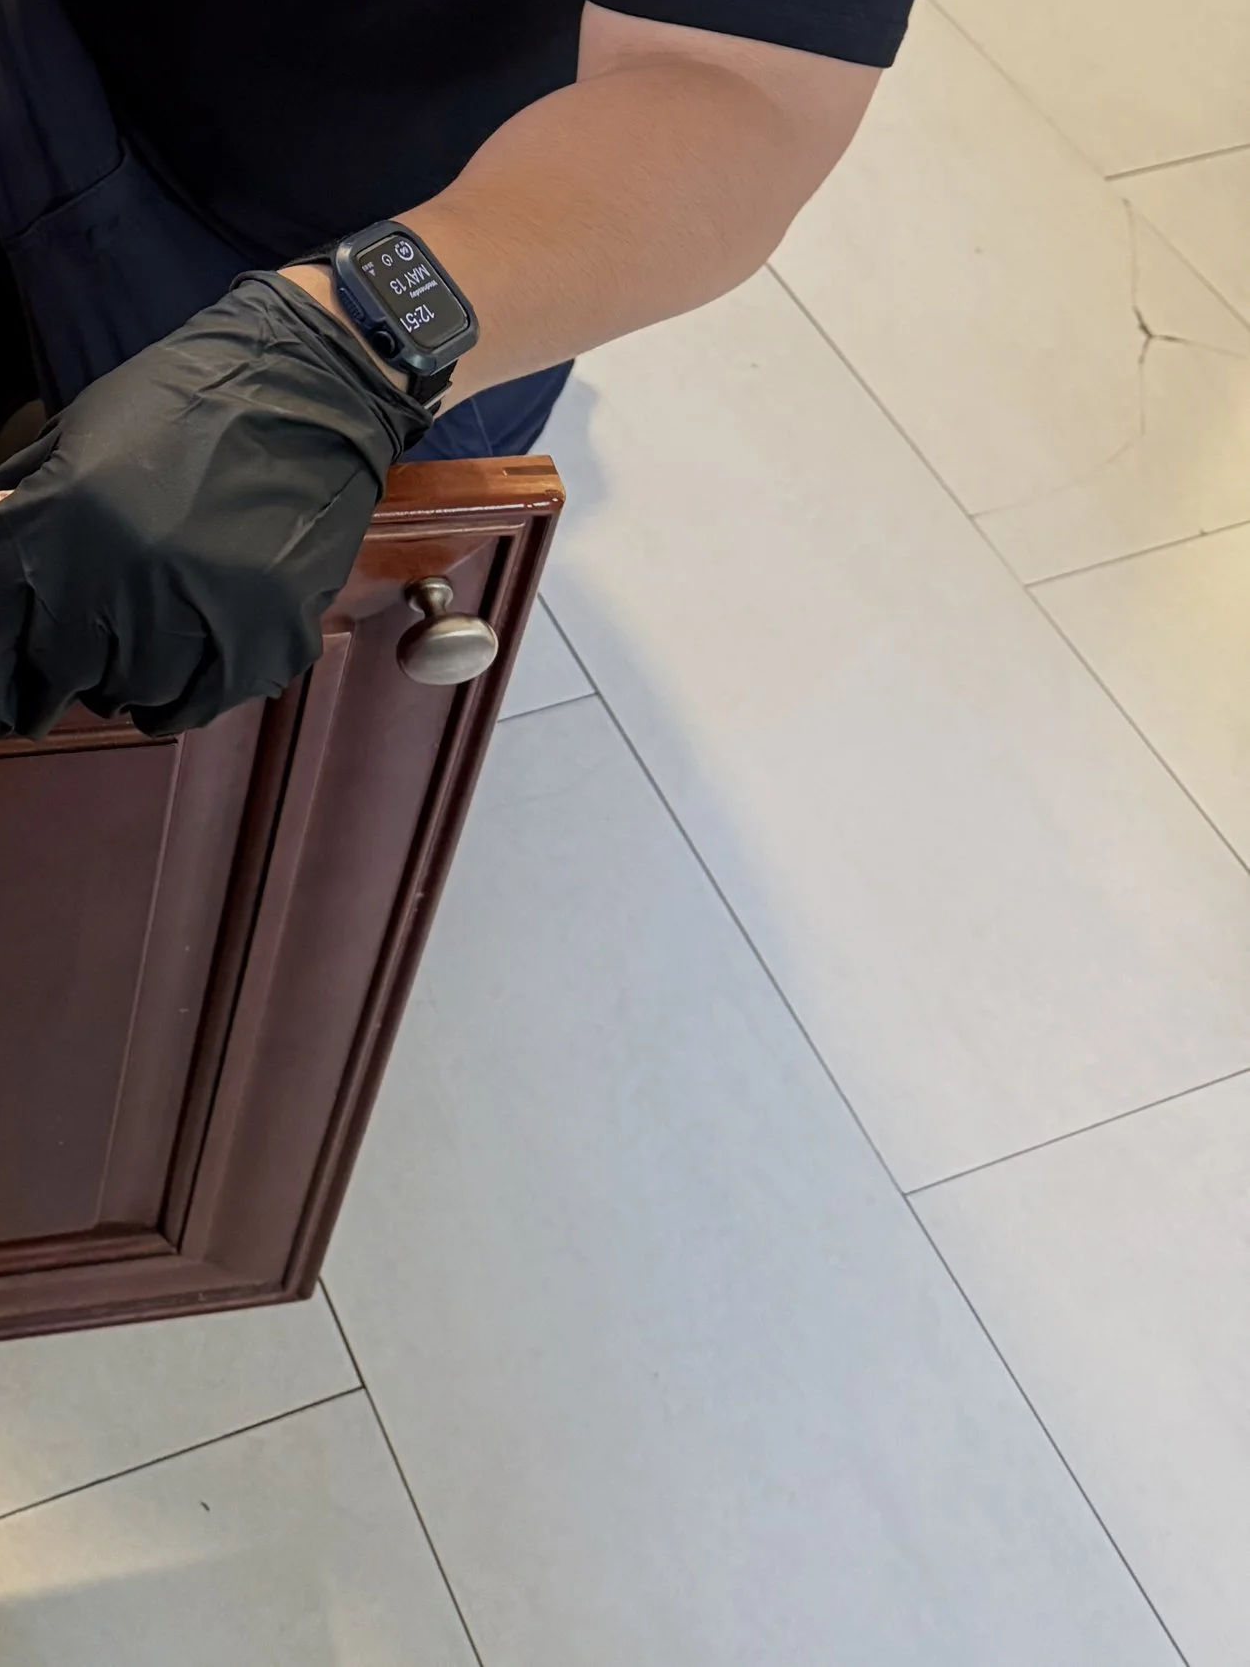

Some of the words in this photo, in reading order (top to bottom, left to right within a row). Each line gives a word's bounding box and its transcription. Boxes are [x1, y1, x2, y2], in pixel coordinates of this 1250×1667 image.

[389, 278, 407, 295] 13
[403, 263, 431, 288] MAY
[409, 279, 438, 299] Wednesday
[399, 303, 435, 333] 12:51
